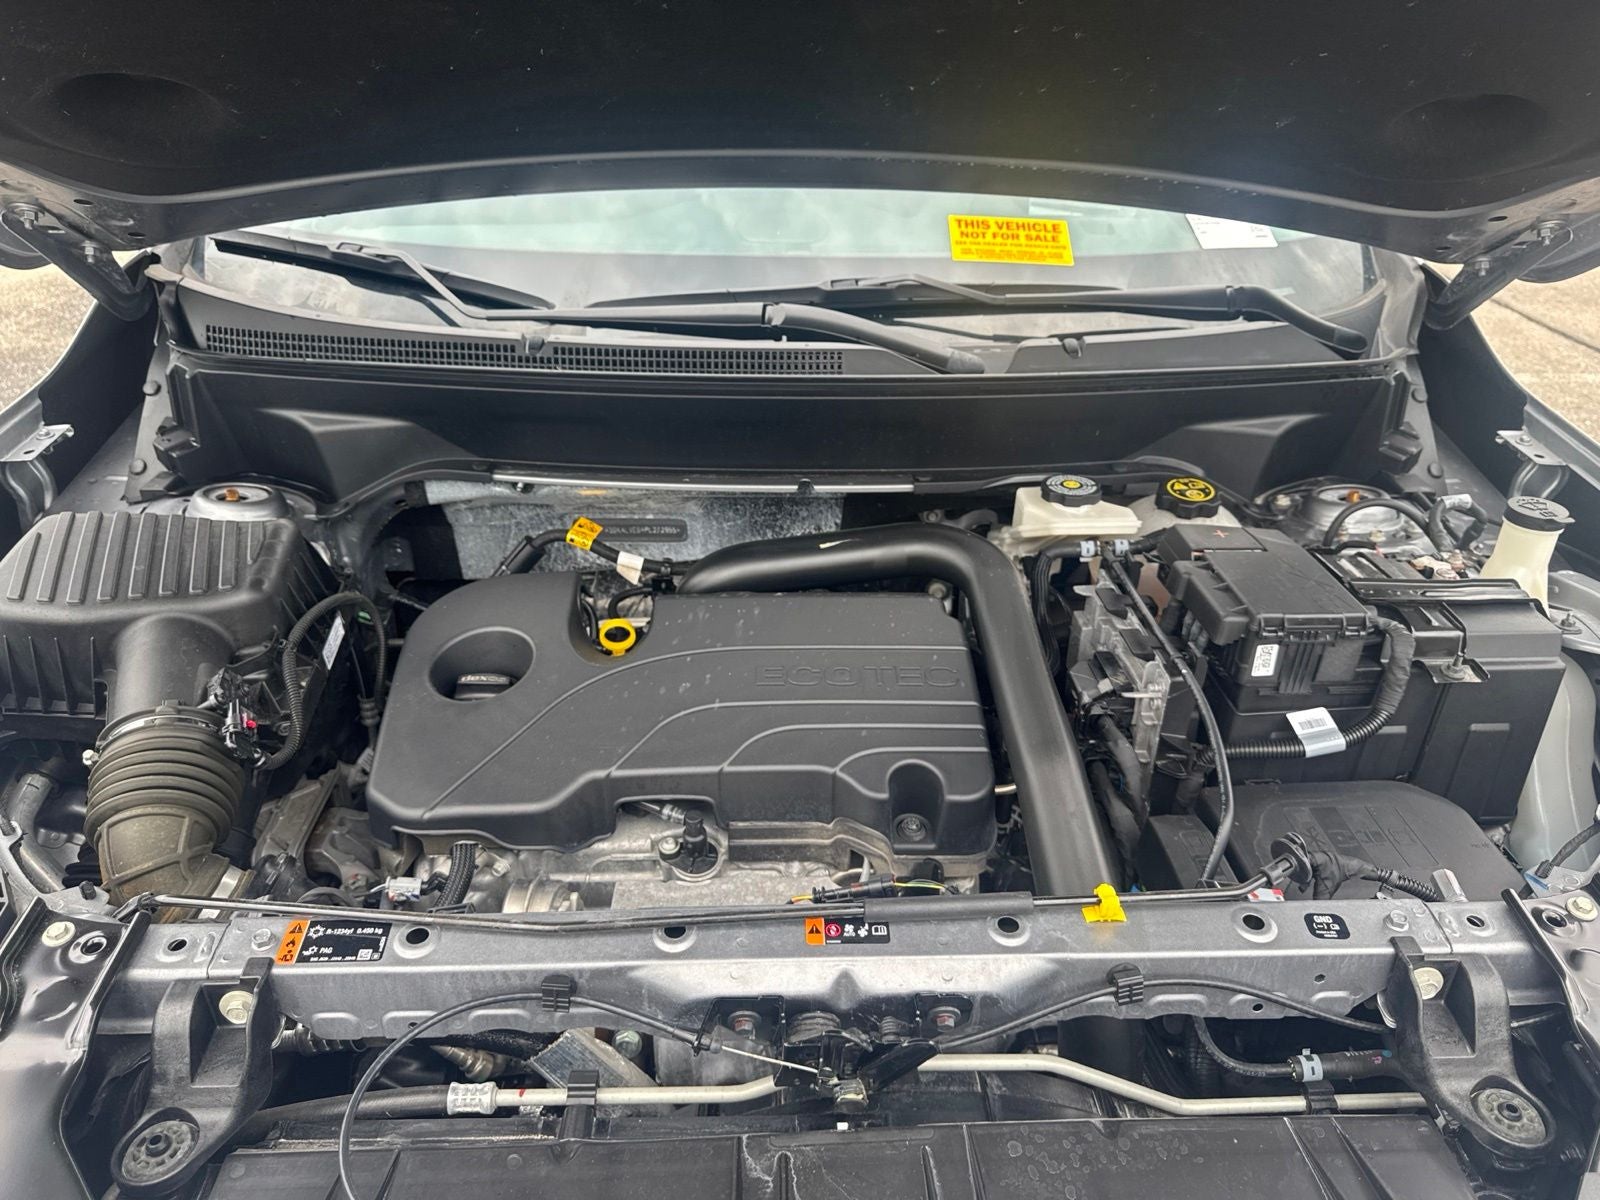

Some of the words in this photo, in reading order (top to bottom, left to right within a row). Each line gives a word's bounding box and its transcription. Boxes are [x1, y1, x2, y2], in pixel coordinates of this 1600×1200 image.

[955, 219, 991, 230] THIS
[995, 221, 1062, 234] VEHICLE
[960, 231, 987, 239] NOT
[992, 232, 1020, 241] FOR
[1025, 234, 1060, 243] SALE
[755, 665, 960, 687] ECOTEC
[1313, 915, 1333, 923] GND
[325, 927, 355, 935] R-1234yf
[374, 927, 383, 935] kg
[319, 946, 333, 954] PAG
